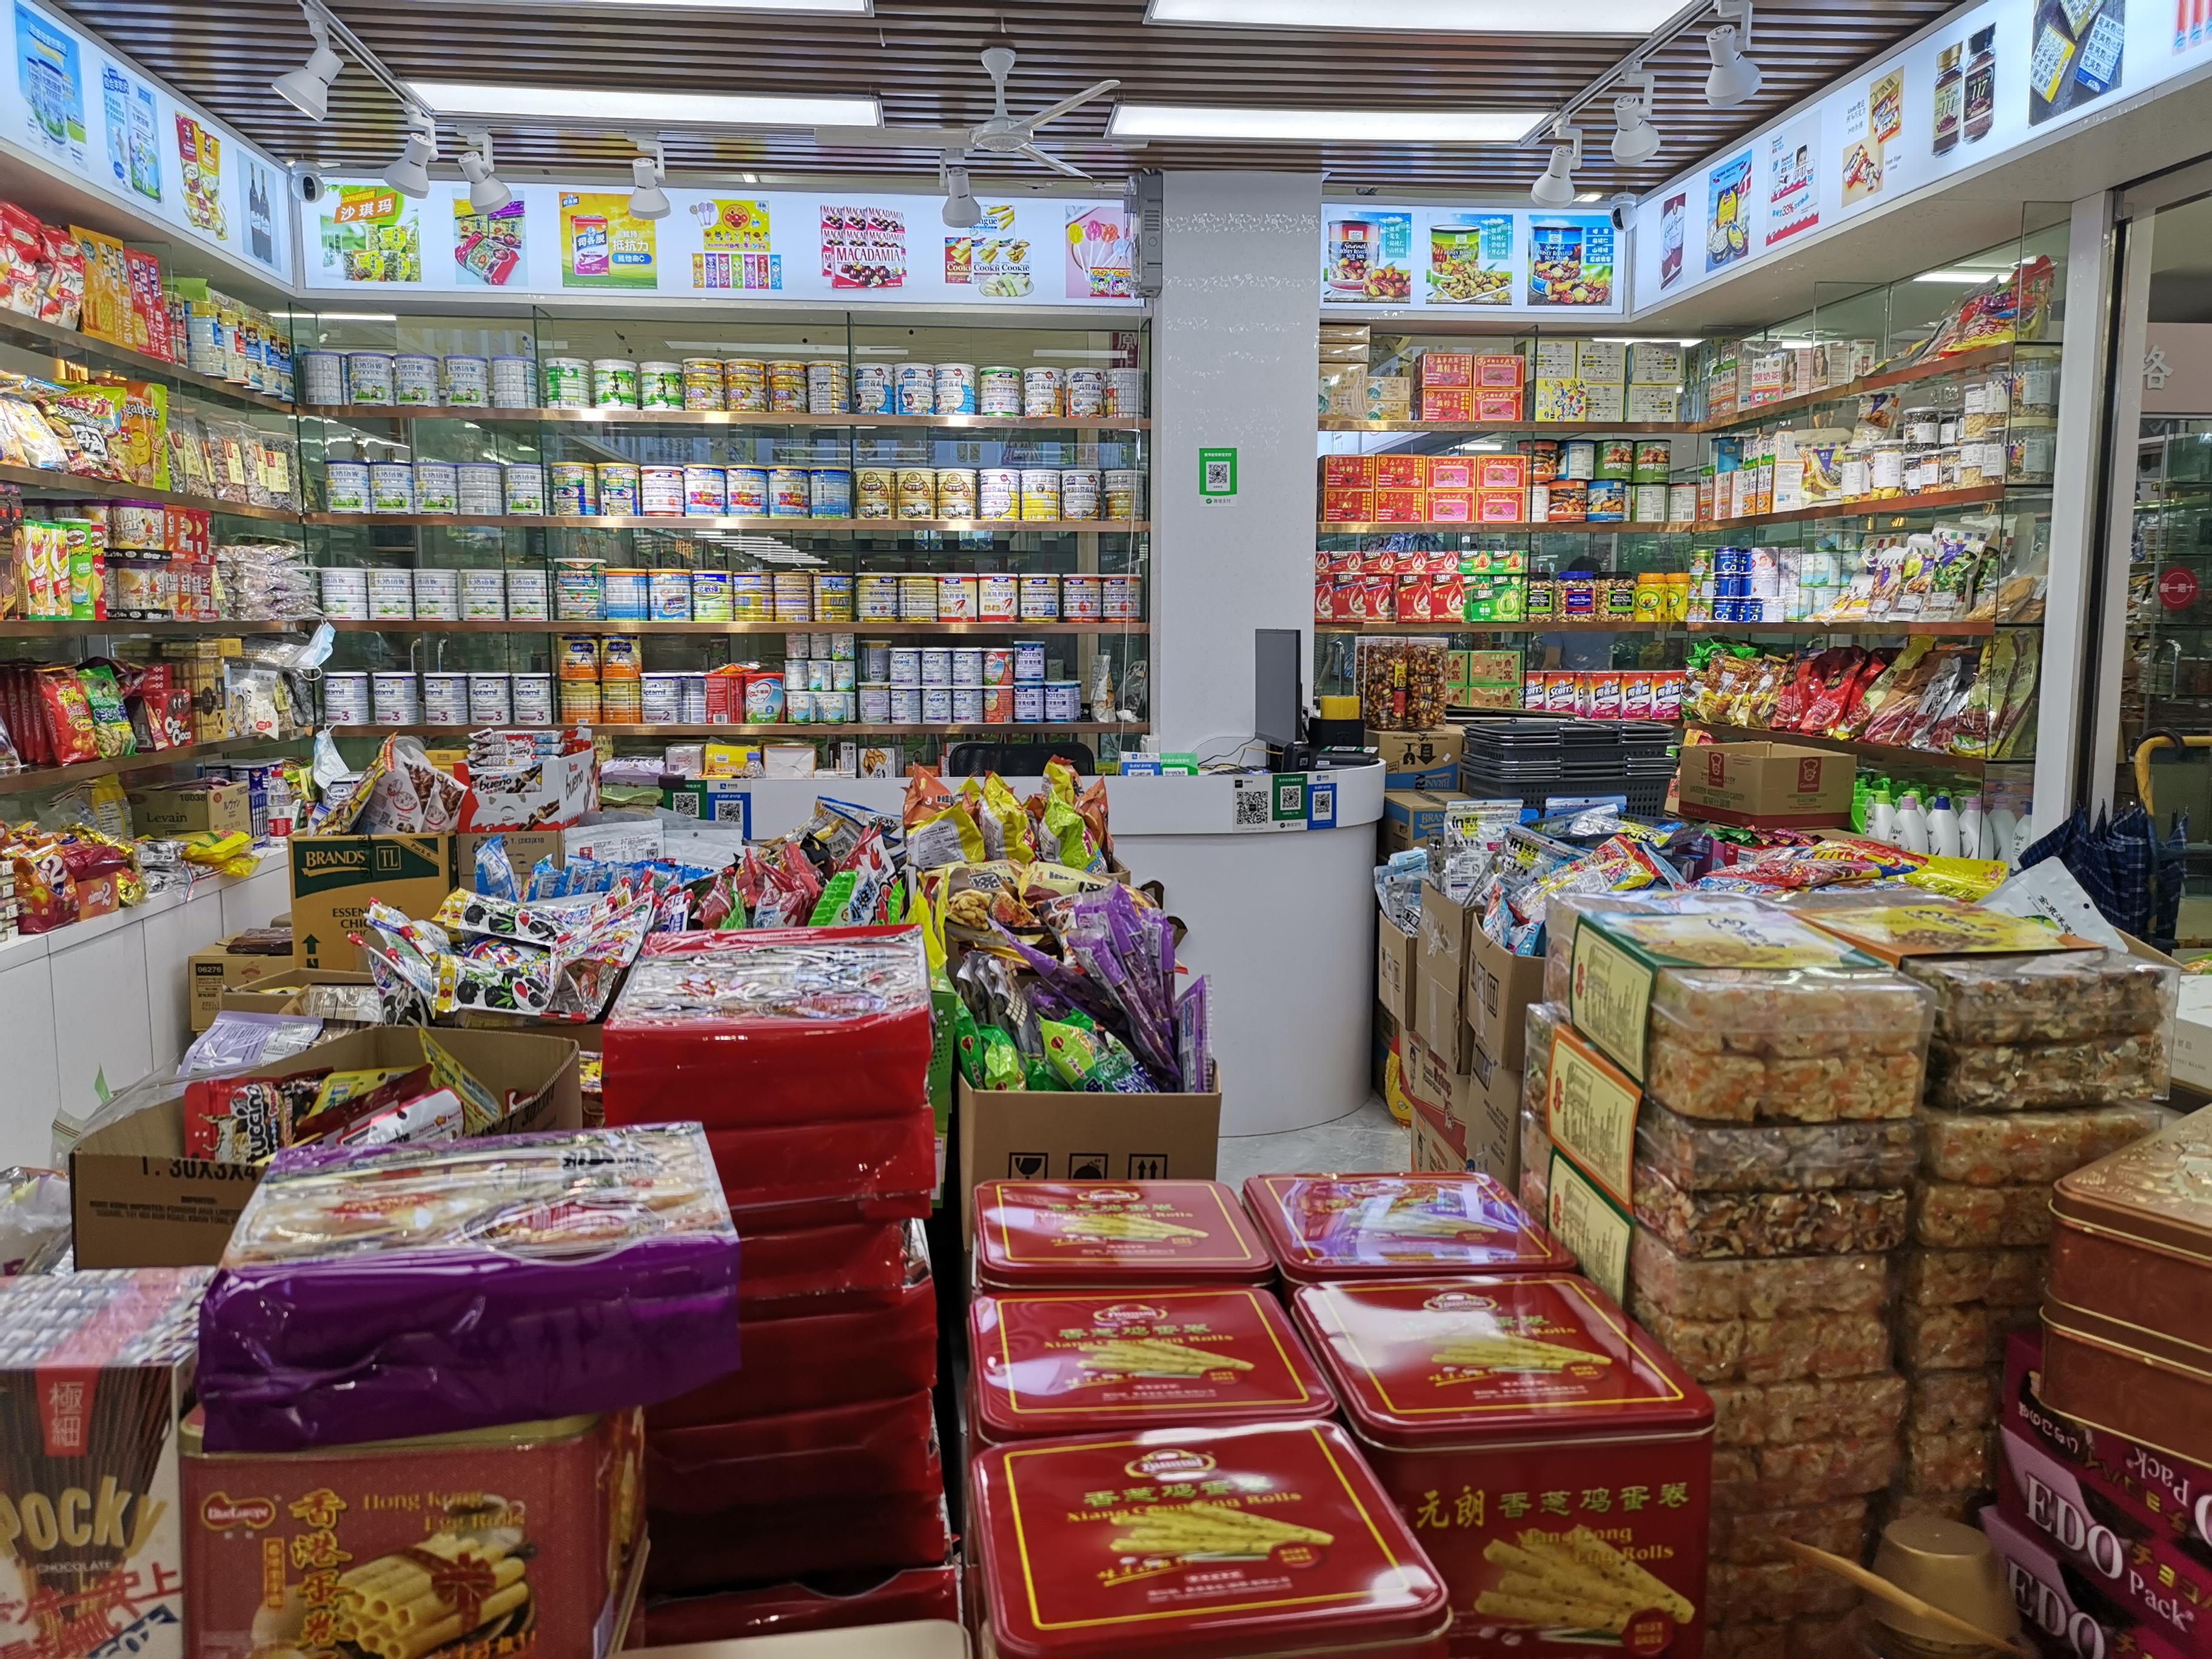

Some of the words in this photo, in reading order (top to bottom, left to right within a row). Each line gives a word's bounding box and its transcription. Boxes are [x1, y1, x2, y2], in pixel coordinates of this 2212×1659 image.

[1972, 80, 1988, 101] 117
[1942, 96, 1955, 115] 114
[340, 198, 393, 222] 沙琪玛
[980, 218, 998, 227] ngue
[612, 239, 649, 252] 抵抗力
[836, 247, 900, 261] MACADAMIA
[126, 403, 159, 418] gabee
[69, 545, 90, 556] ringles
[1723, 561, 1737, 572] Ca
[1715, 611, 1729, 620] Ca
[341, 711, 349, 721] 3
[392, 711, 400, 721] 3
[440, 711, 448, 721] 3
[495, 711, 503, 721] 3
[537, 711, 545, 721] 3
[663, 711, 670, 720] 2
[478, 777, 512, 791] bueno
[566, 769, 583, 801] bueno
[179, 794, 206, 802] 16038
[146, 811, 188, 823] Levain
[1421, 813, 1445, 823] BRAN
[518, 837, 545, 845] (2X3)X10
[2014, 833, 2025, 842] Dove
[410, 842, 425, 854] Pack
[380, 850, 397, 867] TL
[332, 908, 366, 917] ESSEN
[340, 919, 367, 929] CHIC
[169, 1157, 258, 1182] 30X3X4
[49, 1380, 84, 1449] 極細
[364, 1493, 420, 1510] Hong
[1247, 1490, 1303, 1506] Rolls
[1416, 1484, 1486, 1529] 元朗
[2025, 1473, 2124, 1580] EDO
[1623, 1544, 1675, 1563] Rolls
[36, 1560, 112, 1575] CHOCOLATE
[2130, 1569, 2186, 1635] Pack
[2006, 1561, 2105, 1659] EDO
